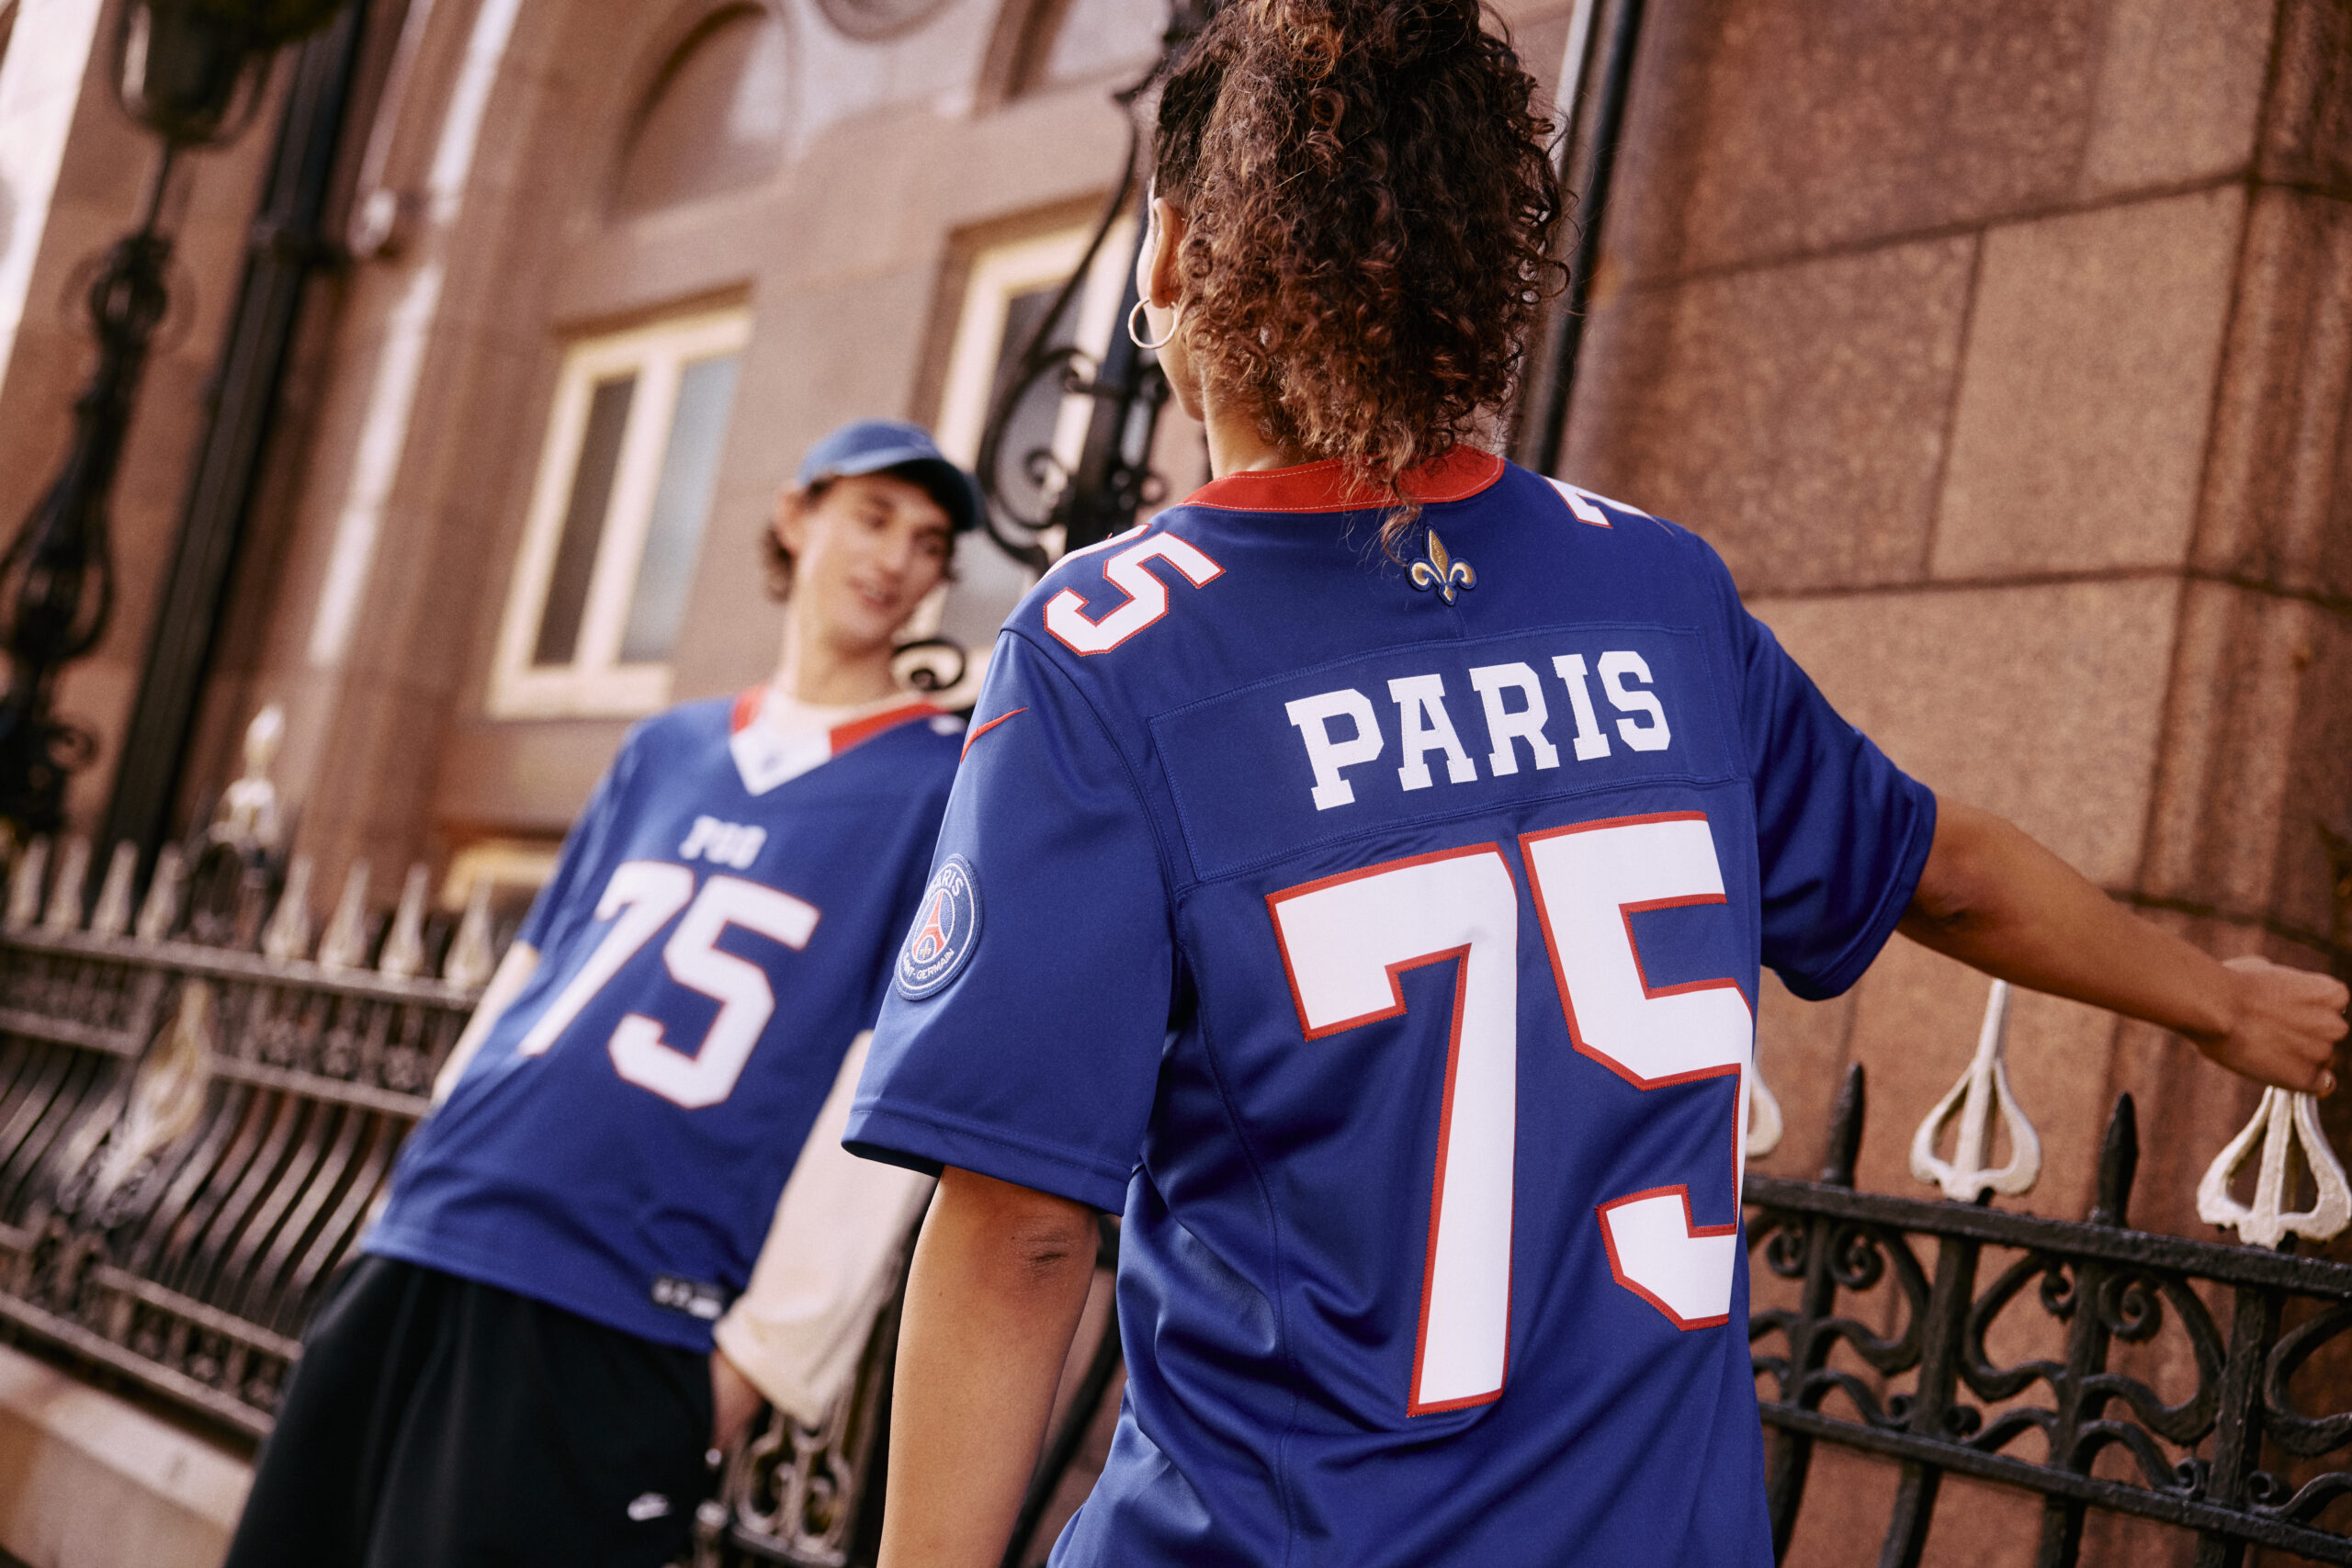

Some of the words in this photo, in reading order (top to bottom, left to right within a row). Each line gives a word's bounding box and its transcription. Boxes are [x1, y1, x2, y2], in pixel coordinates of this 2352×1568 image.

[1285, 650, 1671, 811] PARIS
[516, 858, 822, 1111] 75
[1265, 811, 1754, 1417] 75
